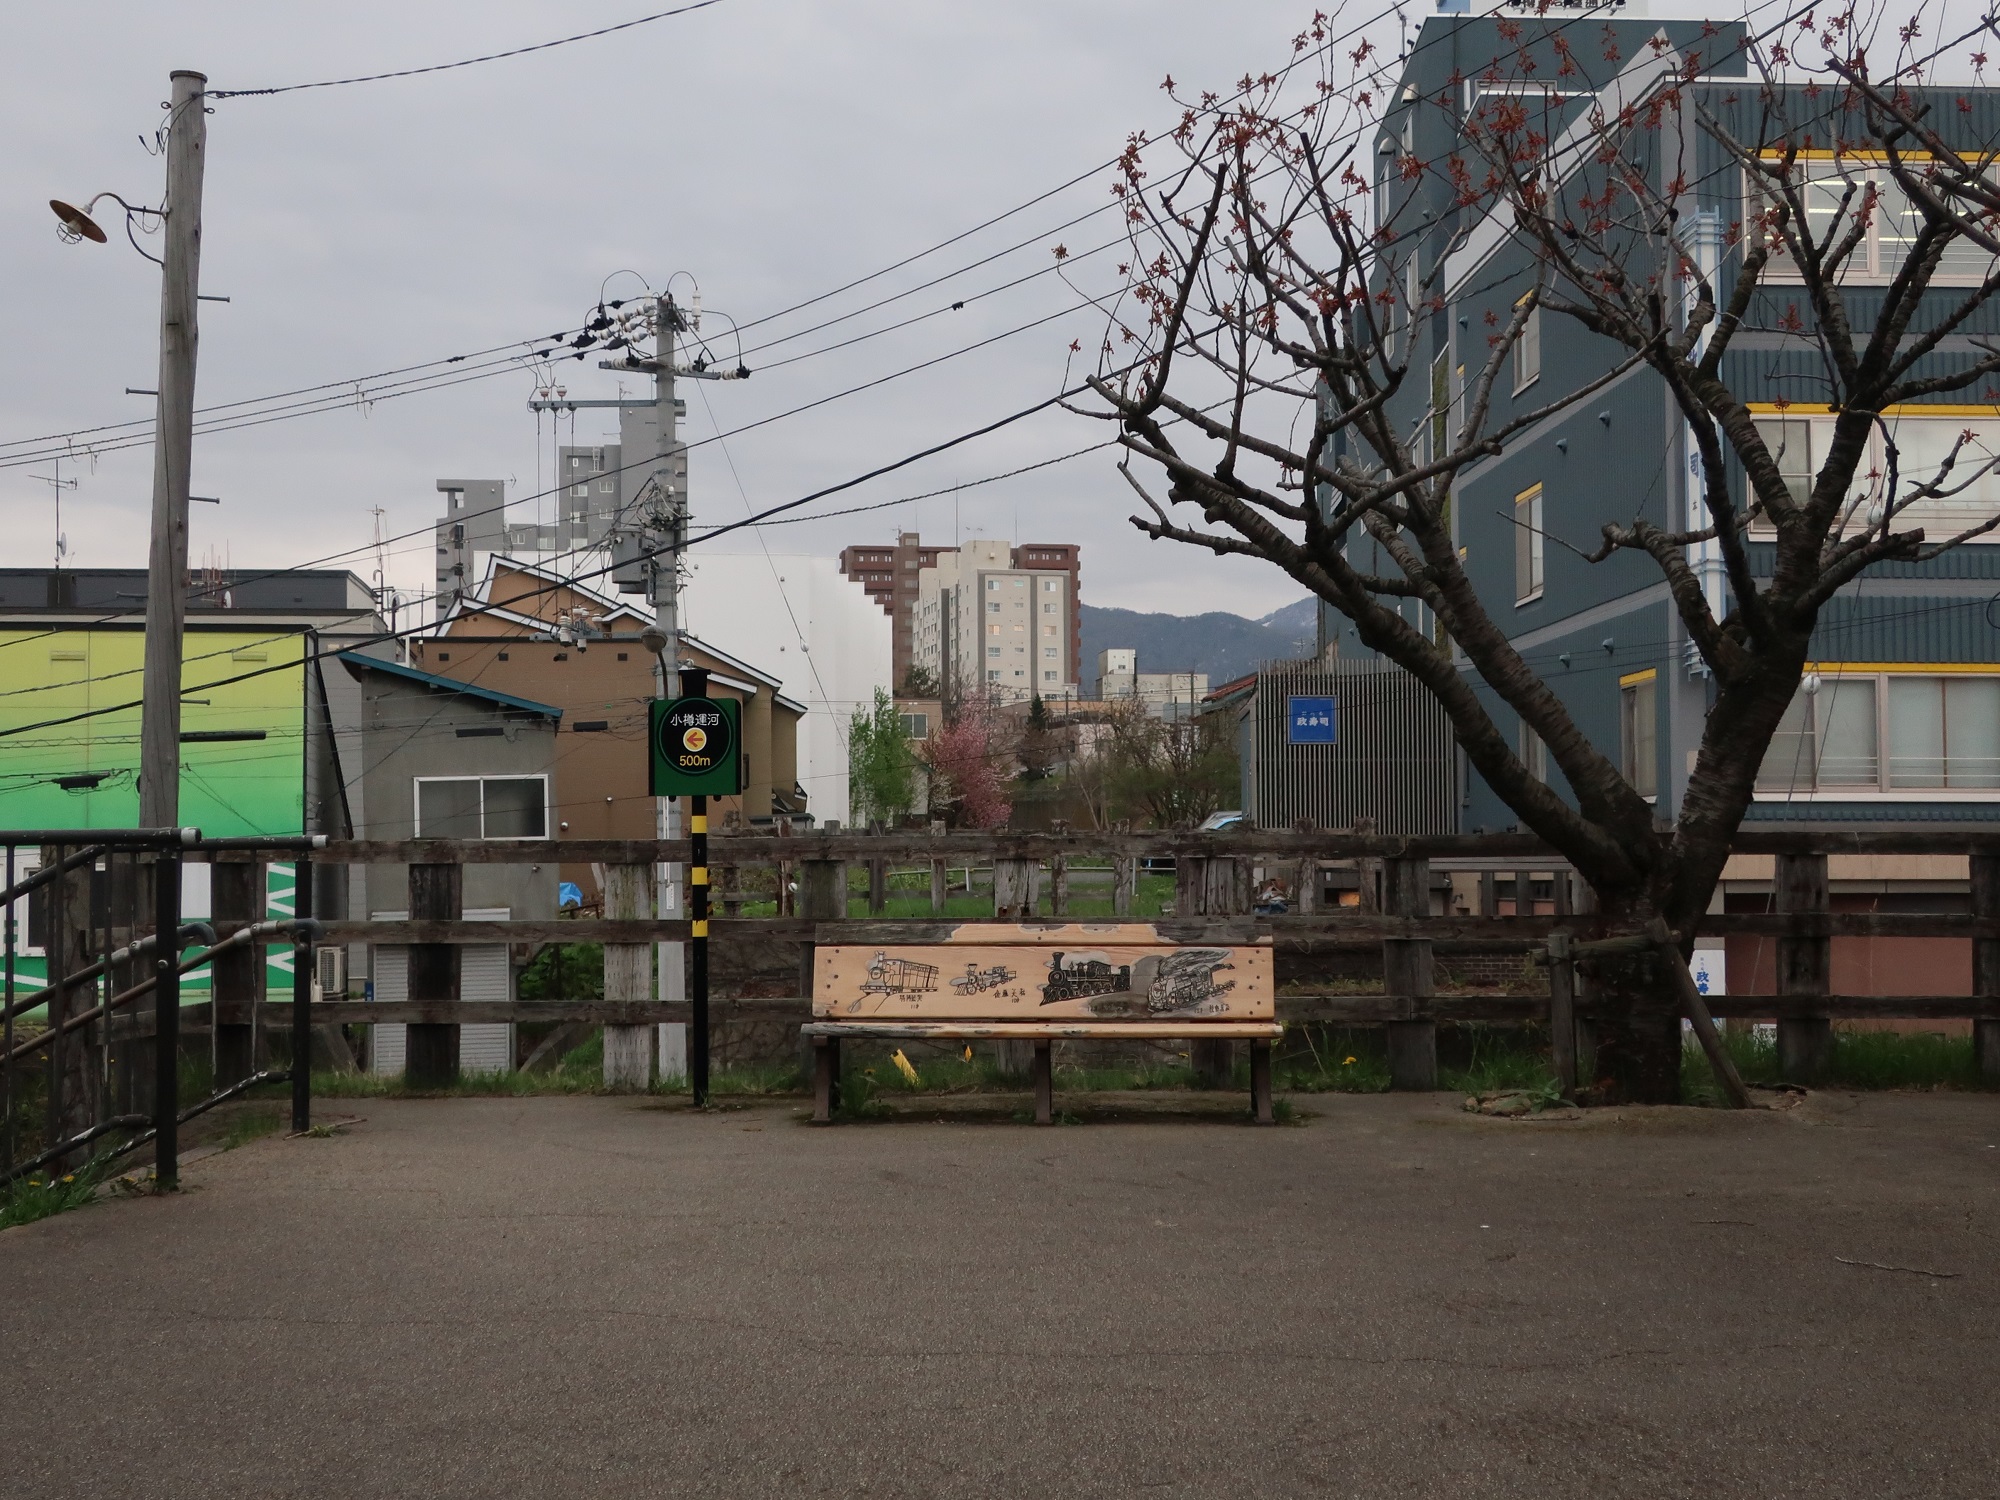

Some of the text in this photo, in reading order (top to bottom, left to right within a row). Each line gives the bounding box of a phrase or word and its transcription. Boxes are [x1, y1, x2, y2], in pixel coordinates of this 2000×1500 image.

[670, 713, 720, 727] 小樽運河
[679, 755, 711, 767] 500m
